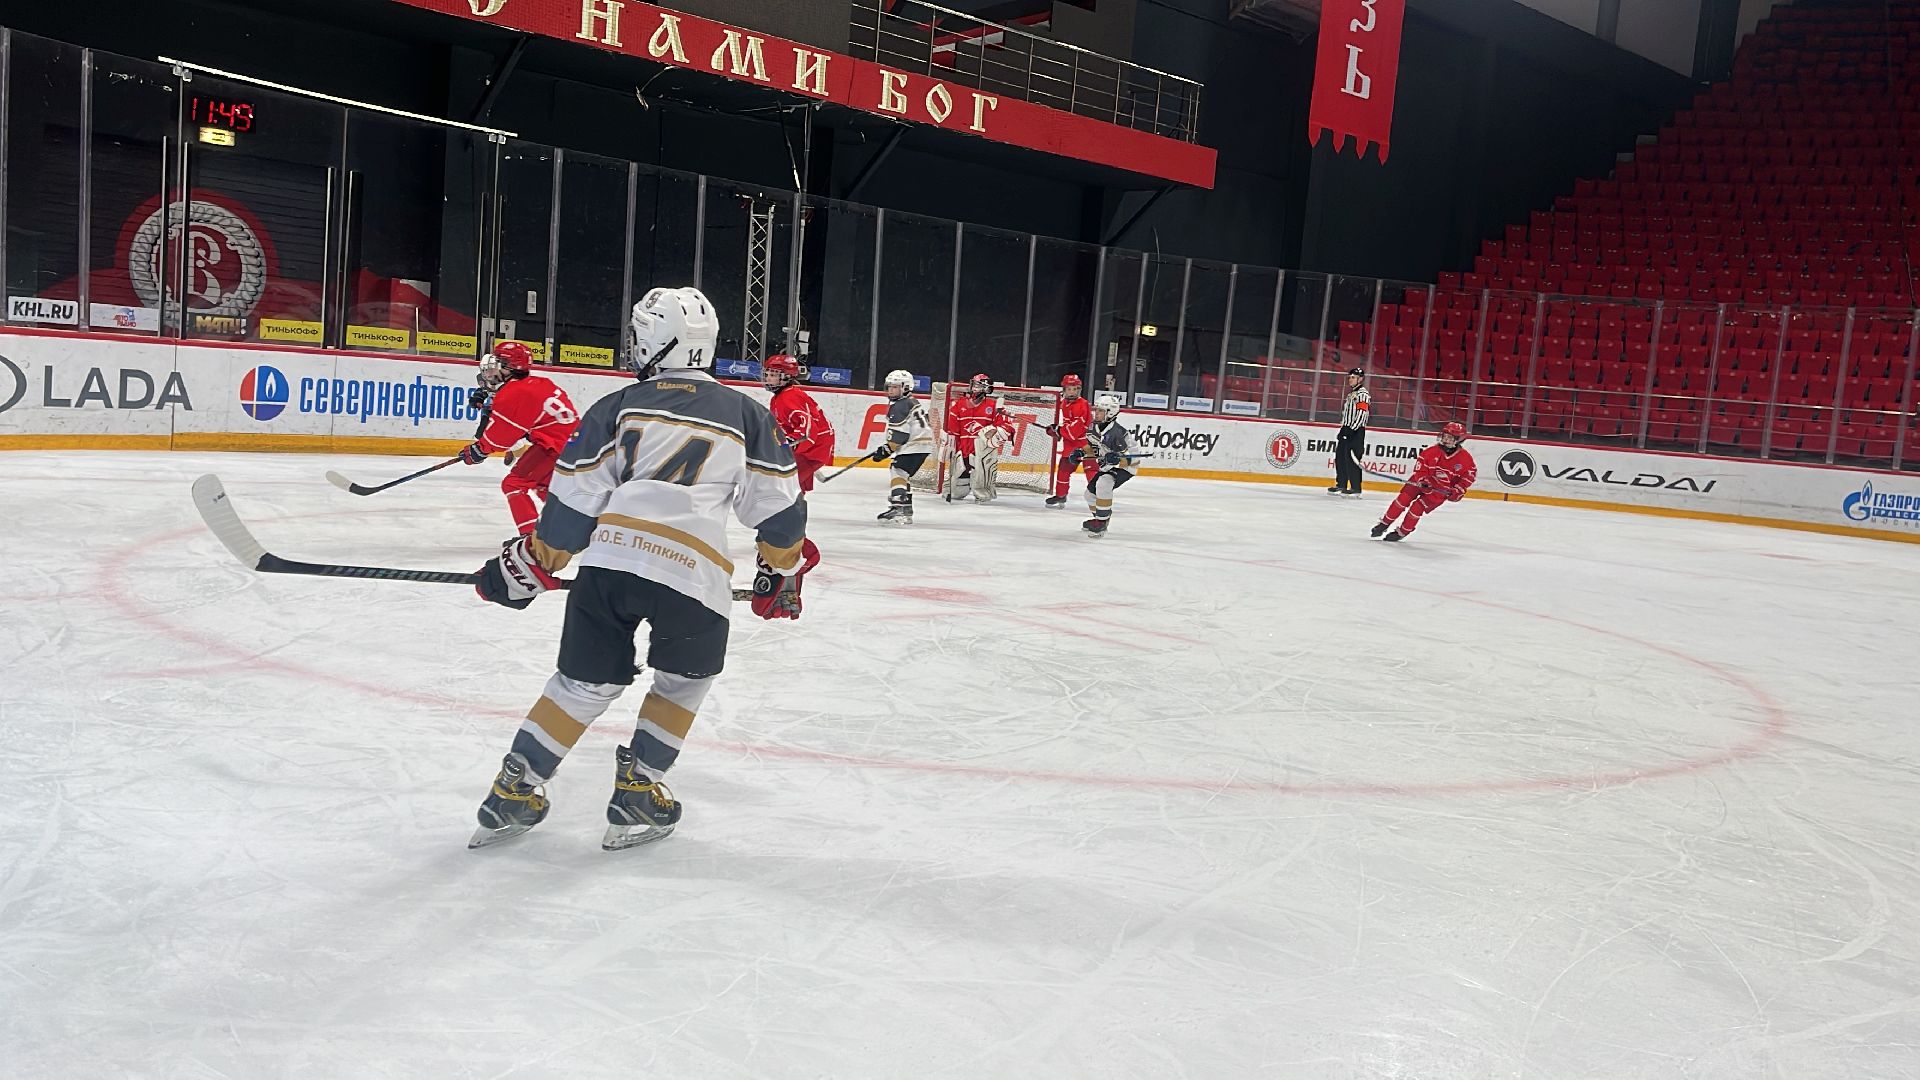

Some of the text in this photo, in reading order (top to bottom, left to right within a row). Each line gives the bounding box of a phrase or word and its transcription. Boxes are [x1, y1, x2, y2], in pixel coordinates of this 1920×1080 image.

[576, 0, 998, 133] НАМИ БОГ
[13, 301, 74, 320] KHL.RU
[265, 325, 319, 336] ТИНЬКОФФ
[352, 332, 404, 343] ТИНЬКОФФ
[422, 338, 472, 348] ТИНЬКОФФ
[565, 350, 609, 360] ТИНЬКОФФ
[687, 348, 703, 367] 14
[43, 365, 193, 411] LADA
[1128, 424, 1220, 456] kHockey
[619, 427, 715, 487] 14
[1541, 464, 1717, 493] VALDAI
[631, 535, 697, 570] Ляпкина
